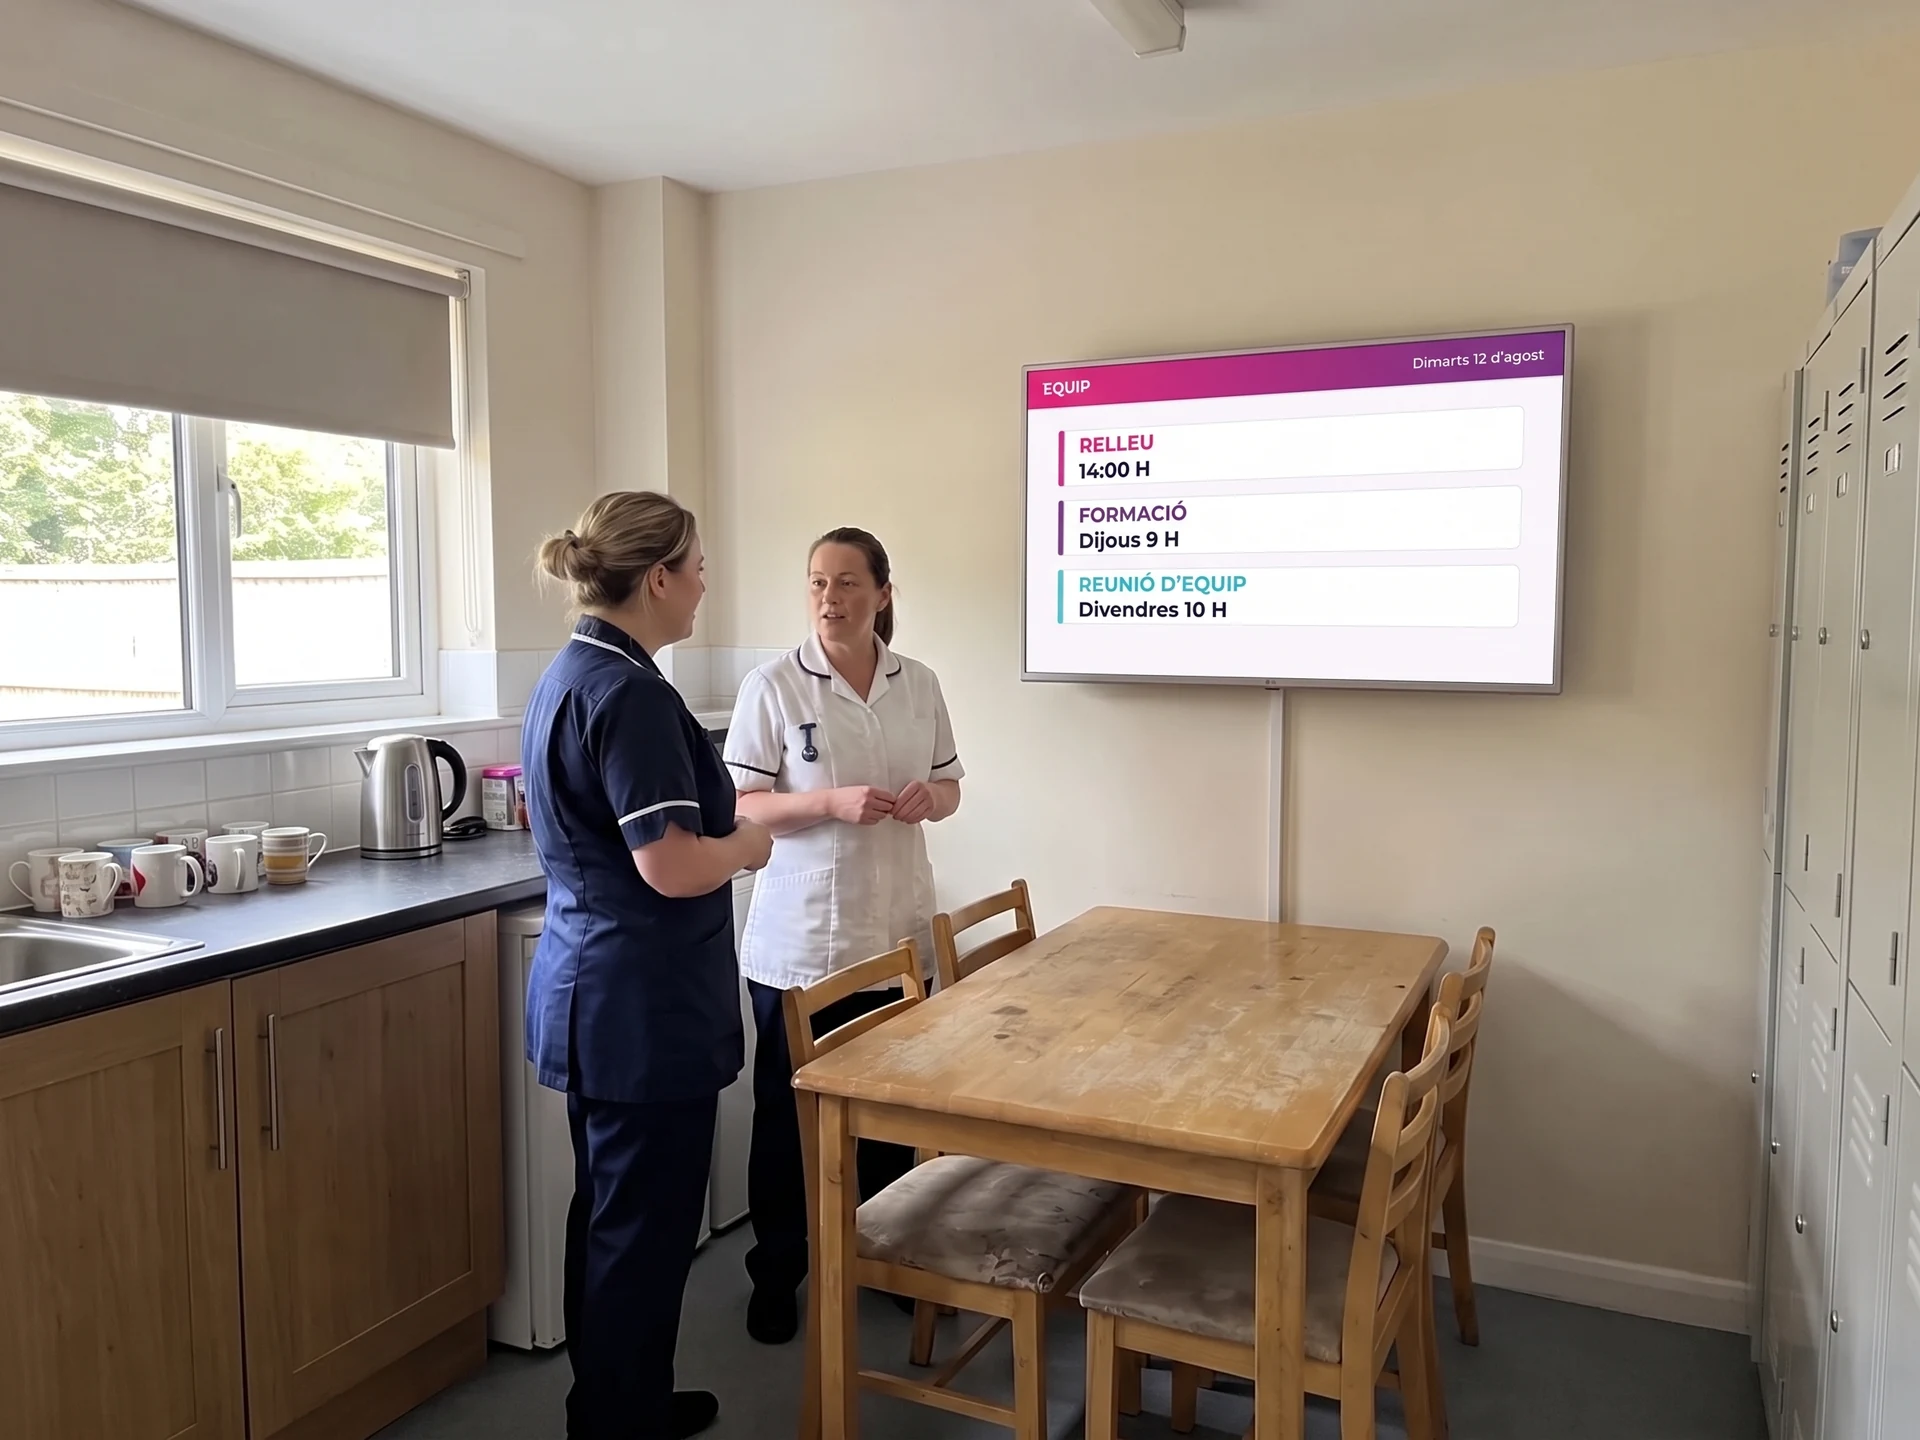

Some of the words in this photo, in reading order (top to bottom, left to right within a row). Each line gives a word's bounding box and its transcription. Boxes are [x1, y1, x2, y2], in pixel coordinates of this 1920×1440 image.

[1412, 355, 1470, 369] Dimarts
[1473, 352, 1487, 365] 12
[1490, 349, 1545, 365] d'agost
[1042, 379, 1091, 397] EQUIP
[1079, 434, 1154, 454] RELLEU
[1079, 461, 1130, 480] 14:00
[1136, 460, 1150, 477] H
[1079, 500, 1188, 524] FORMACIÓ
[1079, 530, 1141, 551] Dijous
[1146, 530, 1159, 548] 9
[1164, 530, 1179, 548] H
[1079, 572, 1156, 593] REUNIÓ
[1161, 574, 1247, 595] D’EQUIP
[1079, 599, 1179, 618] Divendres
[1184, 601, 1206, 618] 10
[1212, 601, 1227, 618] H
